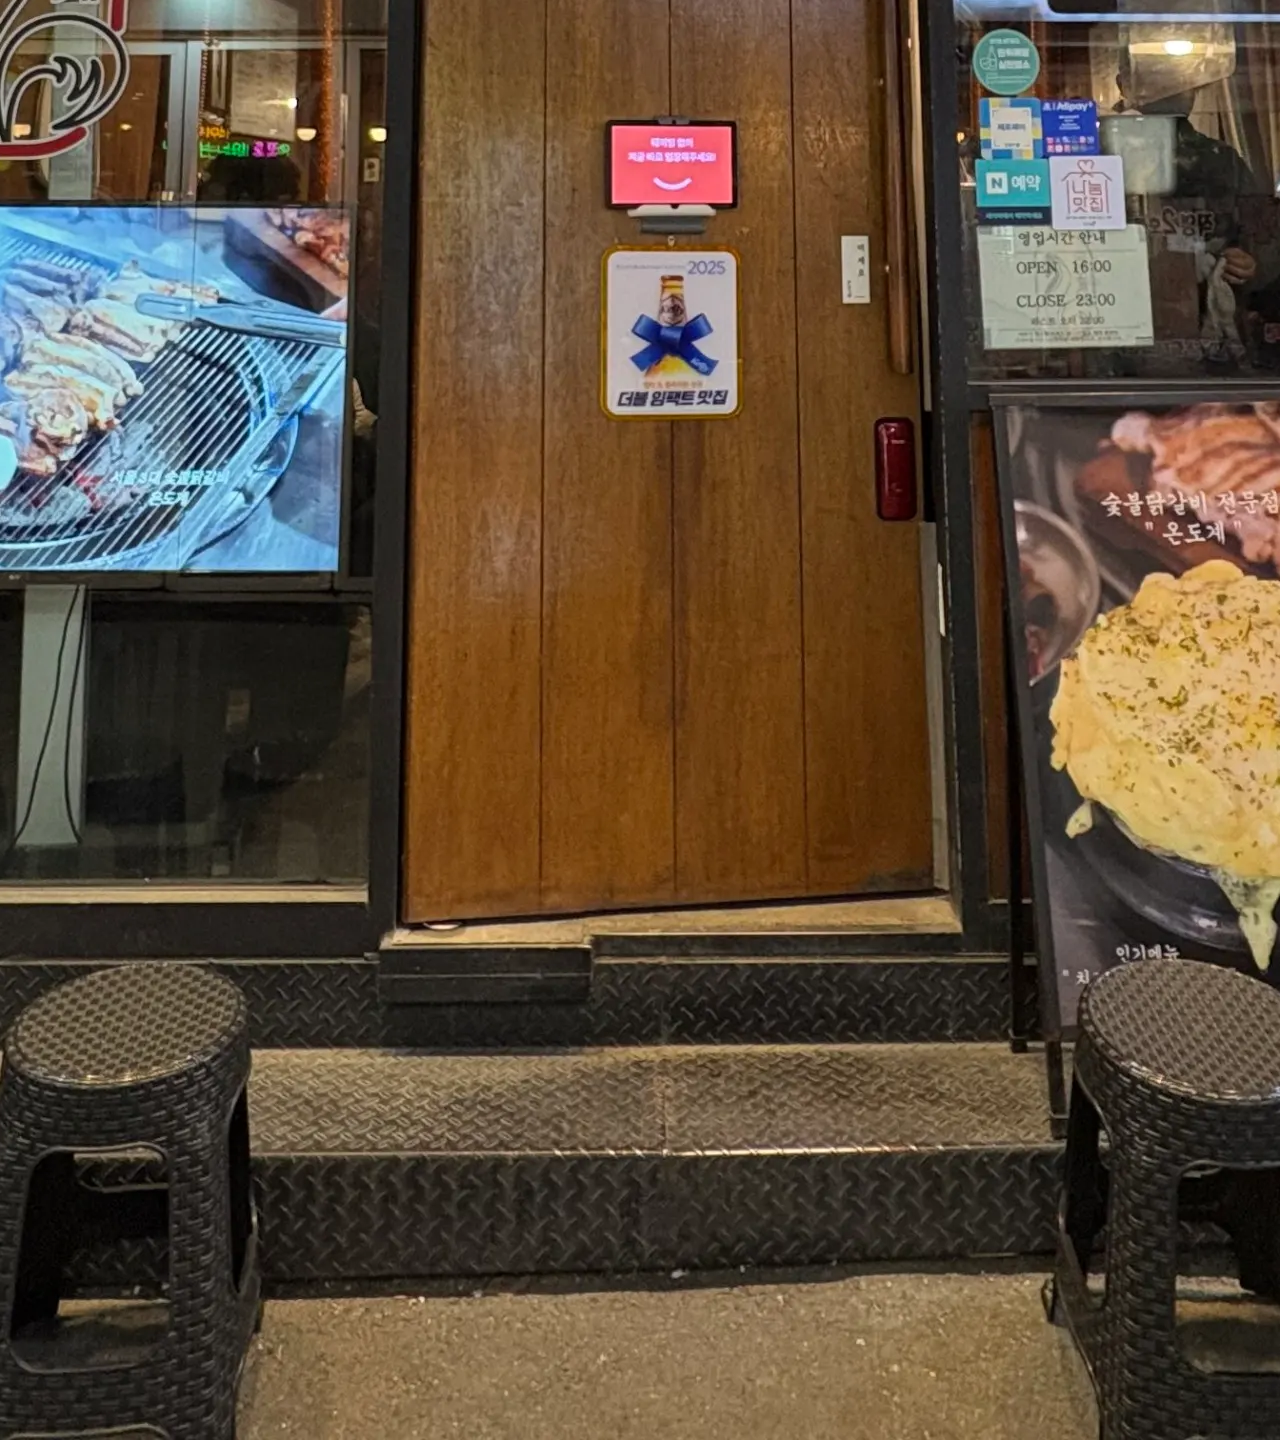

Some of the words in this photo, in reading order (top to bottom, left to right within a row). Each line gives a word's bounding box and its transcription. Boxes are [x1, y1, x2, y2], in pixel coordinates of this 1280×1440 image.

[1011, 174, 1042, 192] 예약
[1073, 197, 1103, 213] 맛집
[1018, 231, 1073, 246] 영업시간
[1079, 231, 1106, 245] 안내
[687, 260, 726, 275] 2025
[1016, 261, 1058, 274] OPEN
[1073, 260, 1112, 273] 16:00
[1016, 294, 1066, 308] CLOSE
[1076, 293, 1116, 307] 23:00
[617, 391, 648, 407] 더블
[650, 390, 696, 407] 임팩트
[697, 389, 728, 405] 맛집
[1101, 490, 1207, 517] 숯불닭갈비
[1217, 490, 1280, 516] 전문점
[1162, 521, 1226, 545] 온도계
